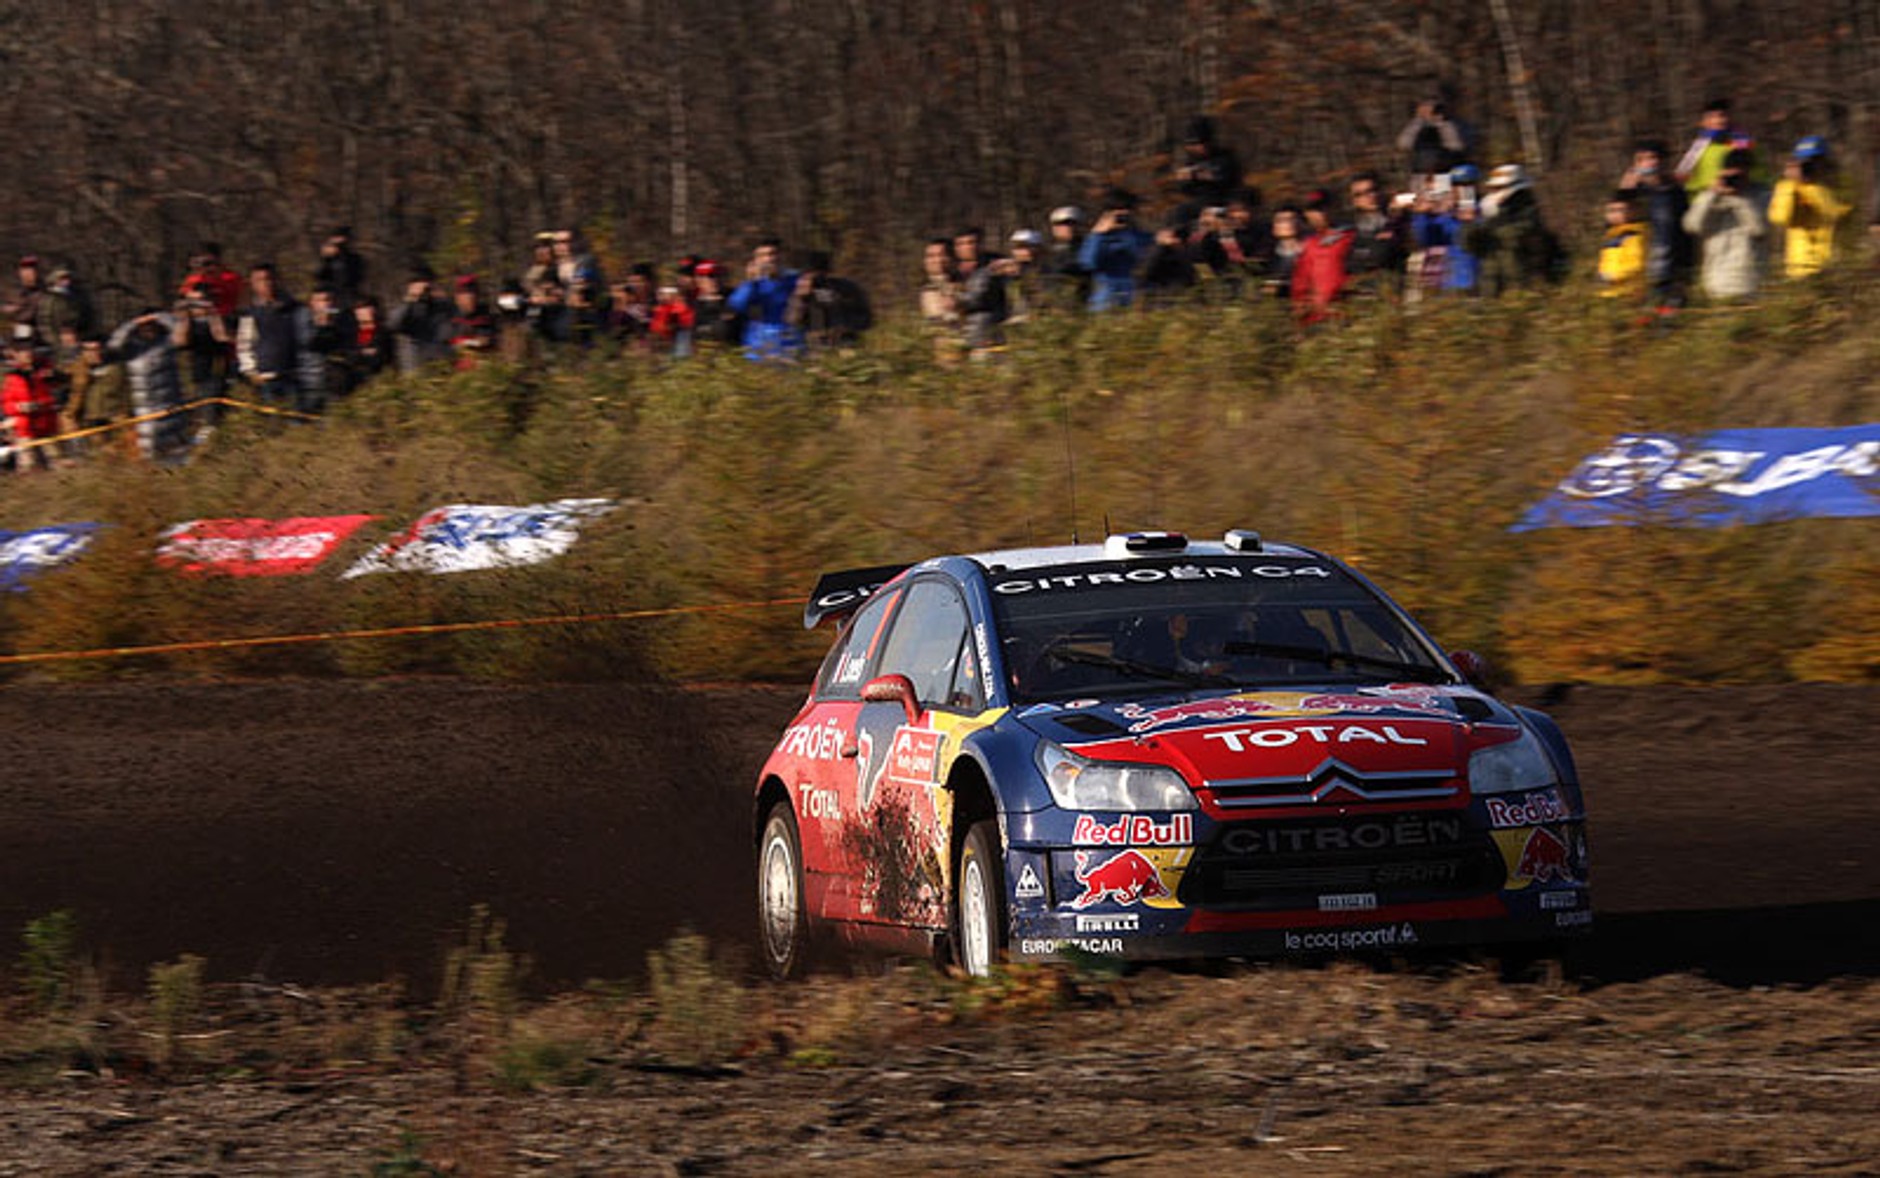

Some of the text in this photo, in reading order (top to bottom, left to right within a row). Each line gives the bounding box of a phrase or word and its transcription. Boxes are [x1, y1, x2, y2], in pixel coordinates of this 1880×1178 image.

[994, 564, 1332, 595] CITROËN C4
[1203, 725, 1428, 752] TOTAL
[799, 783, 842, 820] TOTAL
[1072, 813, 1194, 845] Red Bull
[1222, 814, 1461, 854] CITROËN
[1285, 925, 1396, 950] le coq sportif
